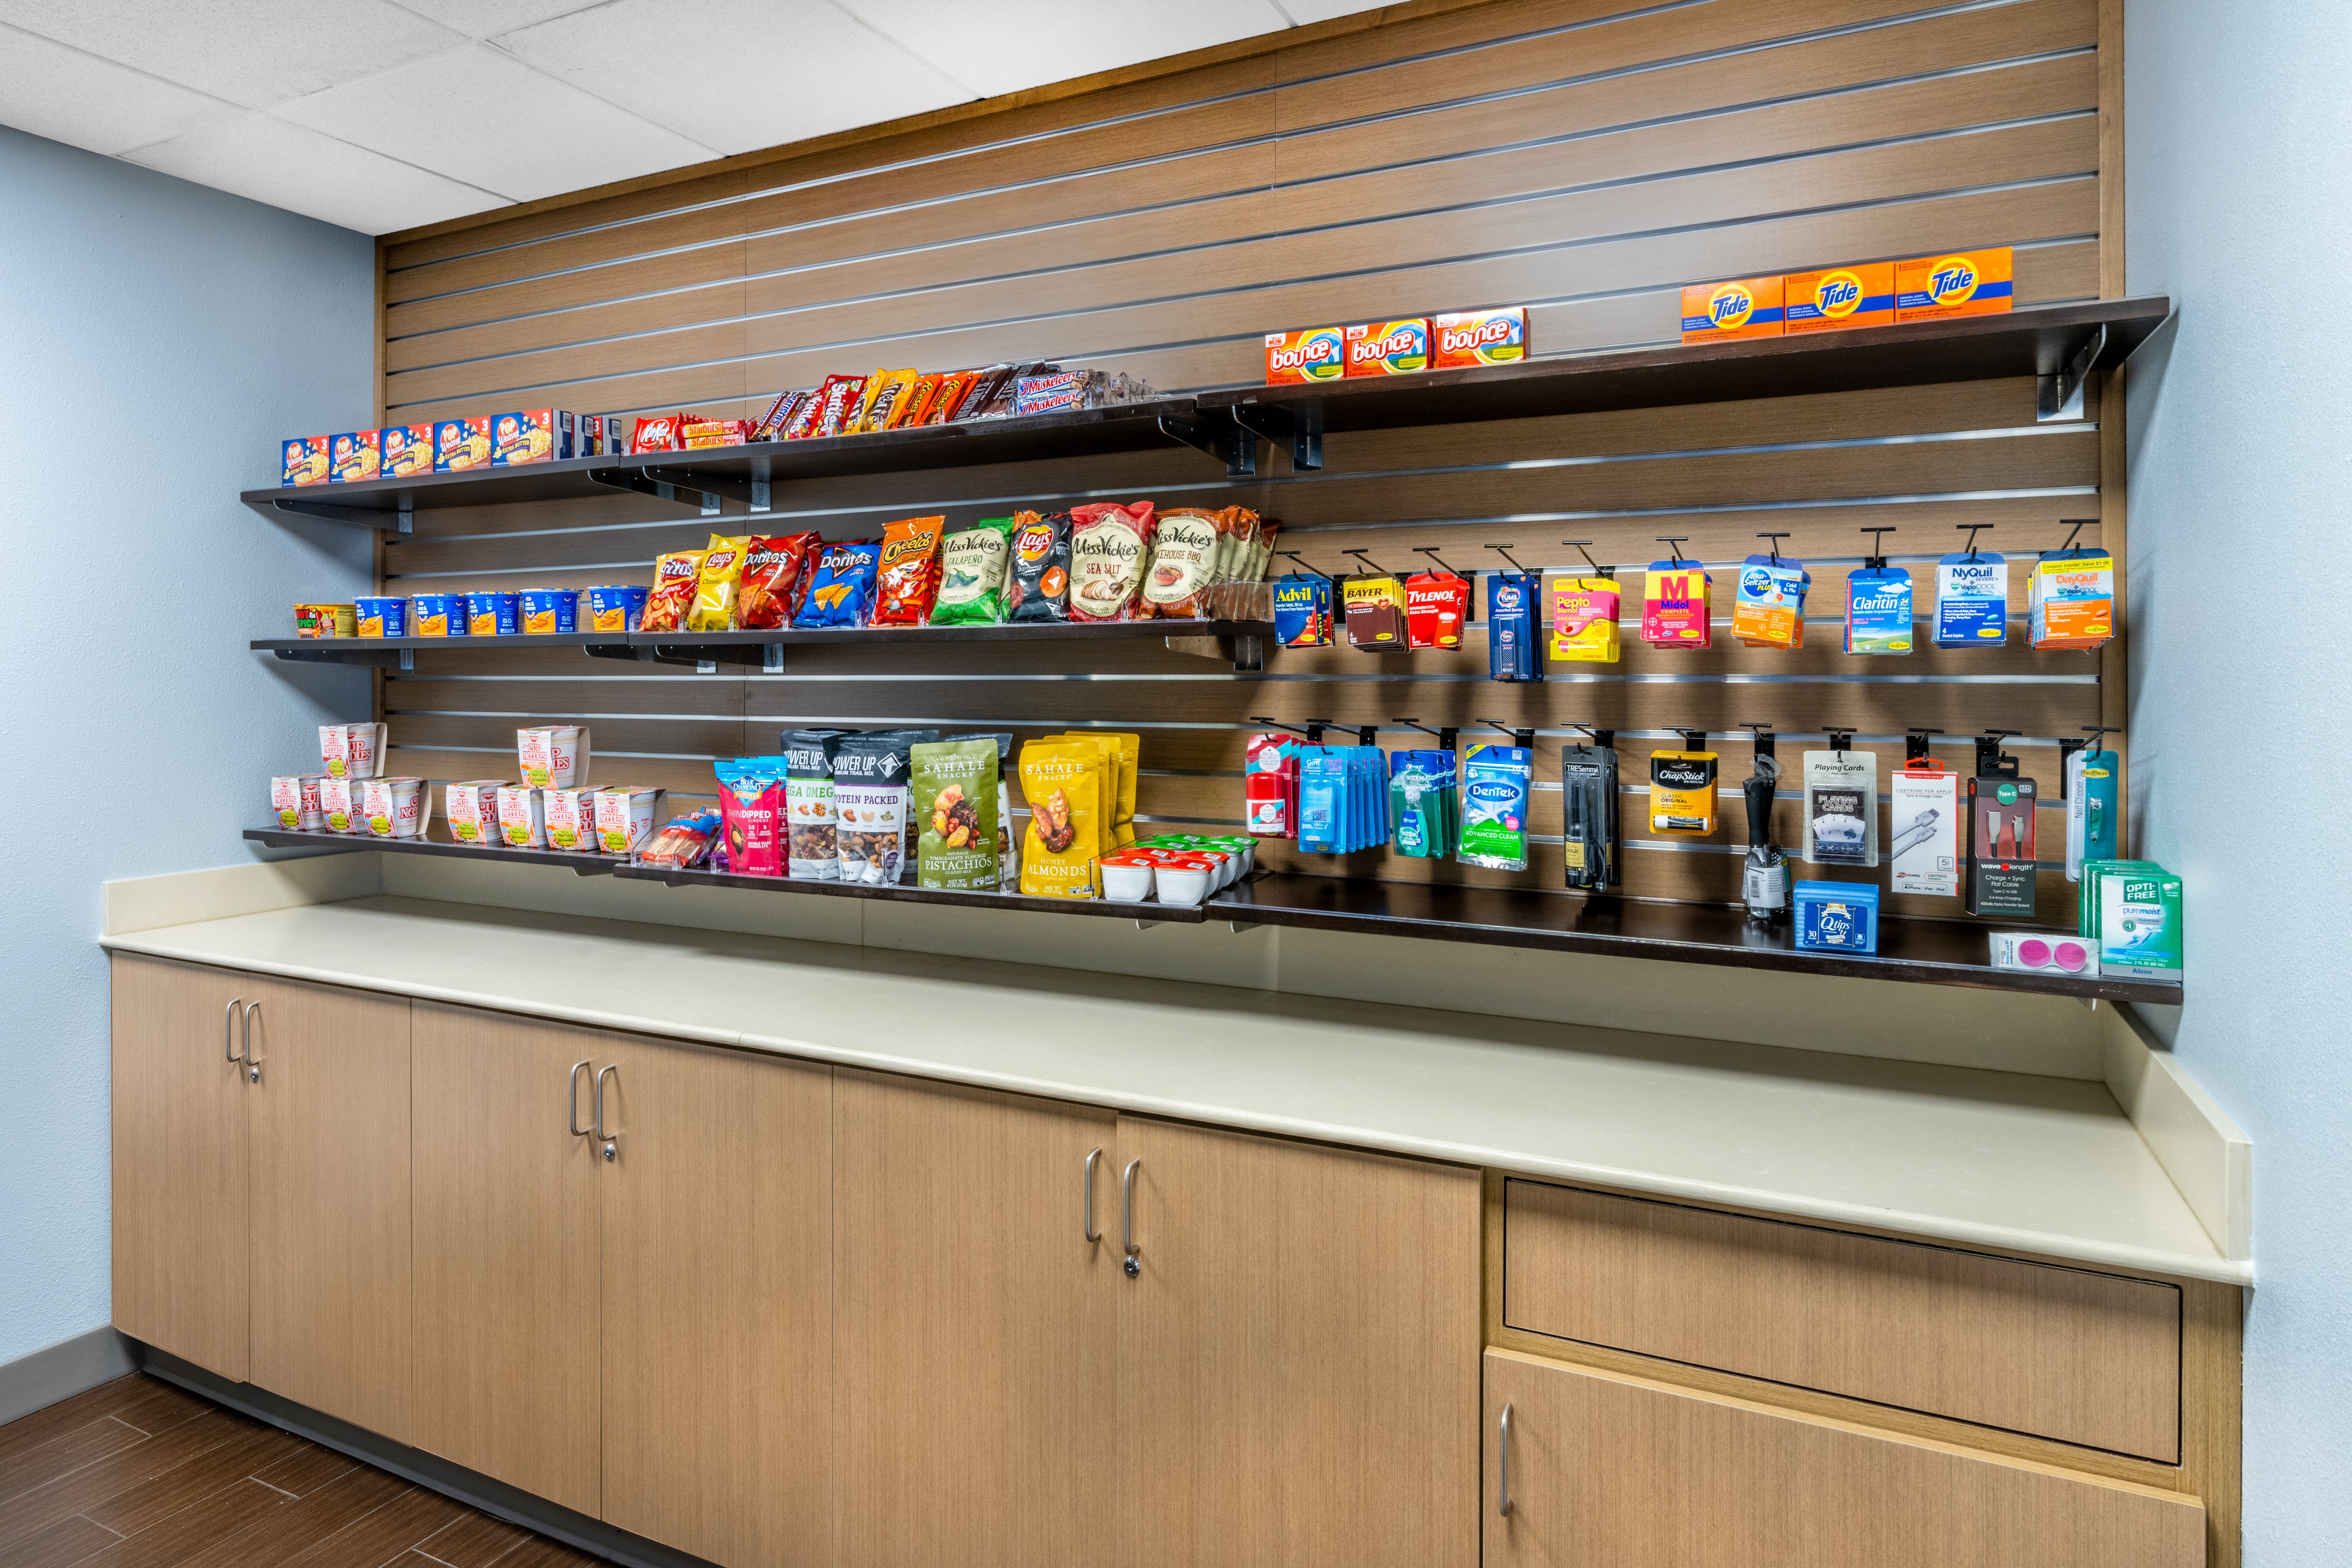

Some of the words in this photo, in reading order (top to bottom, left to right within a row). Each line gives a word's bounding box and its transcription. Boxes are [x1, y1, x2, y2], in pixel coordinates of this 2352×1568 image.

[1931, 267, 1974, 300] Tide
[1819, 281, 1859, 312] Tide
[1713, 294, 1750, 323] Tide
[1443, 320, 1509, 352] bounce
[1352, 332, 1414, 363] bounce
[1020, 381, 1028, 395] 3
[1029, 371, 1077, 393] Musketeers
[910, 380, 933, 413] Reese's
[956, 382, 990, 420] HERSHEY'S
[542, 412, 549, 425] 3
[499, 420, 515, 435] POP
[640, 422, 670, 443] KitKat
[688, 422, 722, 433] Starburst
[388, 433, 402, 448] POP
[497, 430, 519, 446] Weaver
[386, 443, 405, 459] Weaver
[502, 445, 514, 453] EXTRA
[514, 440, 530, 449] BUTTER
[965, 533, 1002, 554] Vickie's
[1018, 532, 1051, 552] Lay's
[1157, 529, 1172, 545] iss
[1172, 525, 1212, 550] Vickie's
[884, 533, 932, 561] Cheetos
[1071, 538, 1101, 555] Miss
[1098, 535, 1139, 561] Vickie's
[706, 551, 735, 568] Lay's
[743, 551, 788, 566] Doritos
[820, 553, 873, 569] Doritos
[895, 552, 920, 564] Crunchy
[947, 555, 983, 566] JALAPEÑO
[1187, 550, 1201, 564] BBQ
[1087, 563, 1101, 574] SEA
[1105, 564, 1121, 574] SALT
[1952, 567, 1993, 580] NyQuil
[1744, 578, 1770, 586] Seltzer
[2056, 572, 2098, 586] DayQuil
[1276, 587, 1311, 602] Advil
[1347, 588, 1383, 598] BAYER
[1408, 591, 1455, 604] TYLENOL
[1557, 596, 1590, 608] Pepto
[1661, 600, 1689, 609] Midol
[1853, 597, 1898, 610] Claritin
[296, 610, 309, 619] HOT
[297, 619, 316, 627] SPICY
[328, 737, 339, 746] CUP
[324, 745, 344, 753] NOODLES
[863, 757, 876, 771] UP
[924, 761, 984, 773] SAHALE
[1306, 758, 1322, 767] Secret
[1659, 770, 1704, 781] ChapStick
[1472, 786, 1515, 798] DenTek
[2074, 781, 2083, 804] Clipper
[864, 795, 898, 804] PACKED
[1818, 795, 1858, 804] PLAYING
[1822, 803, 1854, 812] CARDS
[2074, 805, 2082, 818] Nail
[1466, 830, 1497, 839] ADVANCED
[925, 857, 992, 871] PISTACHIOS
[1028, 865, 1086, 876] ALMONDS
[2009, 864, 2031, 872] length
[2126, 883, 2156, 893] OPTI-
[2127, 891, 2156, 900] FREE
[2123, 907, 2160, 915] puremoist
